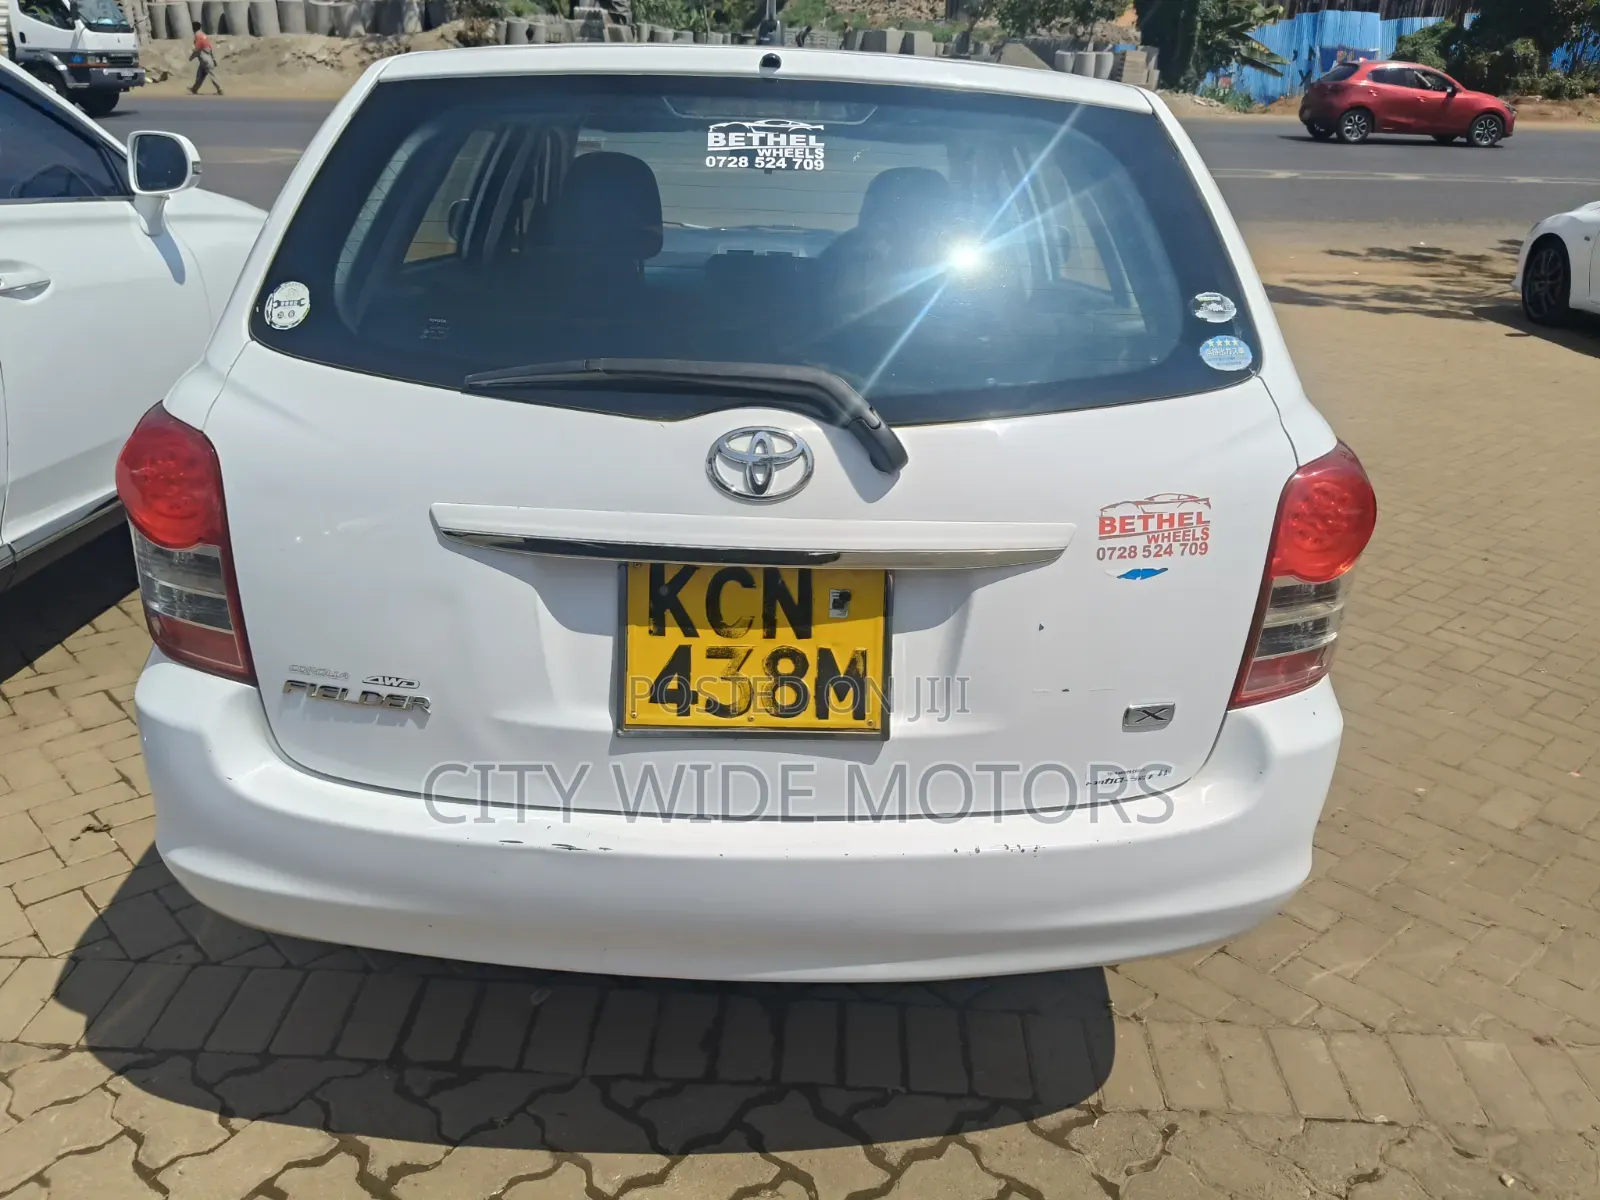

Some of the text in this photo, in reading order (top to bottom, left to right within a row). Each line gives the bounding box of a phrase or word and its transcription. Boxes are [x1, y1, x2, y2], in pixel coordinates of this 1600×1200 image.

[707, 132, 825, 147] BETHEL
[757, 148, 825, 159] WHEELS
[705, 156, 825, 171] 0728 524 709
[1098, 511, 1211, 536] BETHEL
[1146, 526, 1210, 545] WHEELS
[1096, 542, 1209, 561] 0728 524 709
[648, 563, 813, 639] KCN
[289, 664, 349, 680] COROLLA
[362, 675, 421, 690] 4WD
[648, 644, 868, 721] 438M
[282, 679, 432, 714] FIELDER
